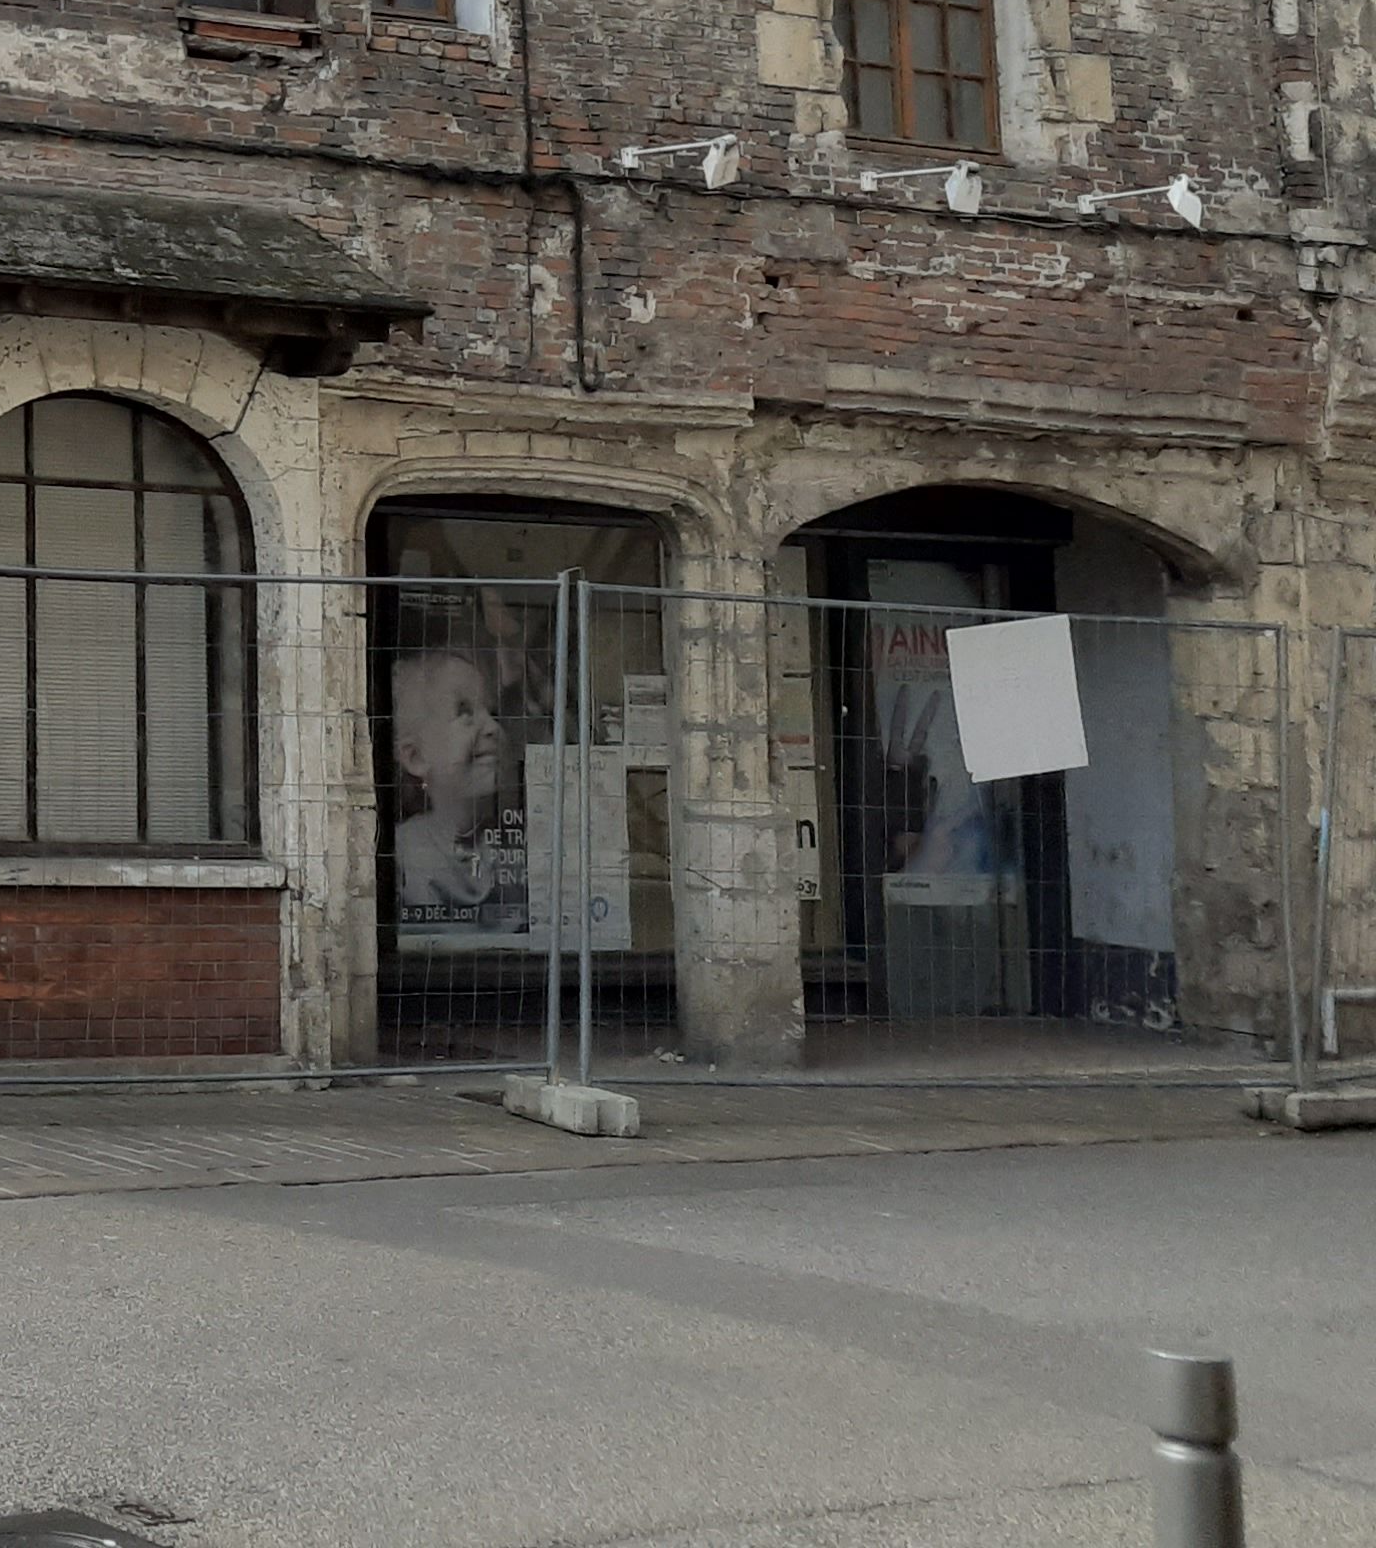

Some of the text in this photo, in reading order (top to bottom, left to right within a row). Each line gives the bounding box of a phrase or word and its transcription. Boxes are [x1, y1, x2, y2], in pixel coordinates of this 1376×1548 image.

[503, 809, 524, 825] ON
[484, 829, 502, 845] DE
[453, 907, 480, 920] 2017
